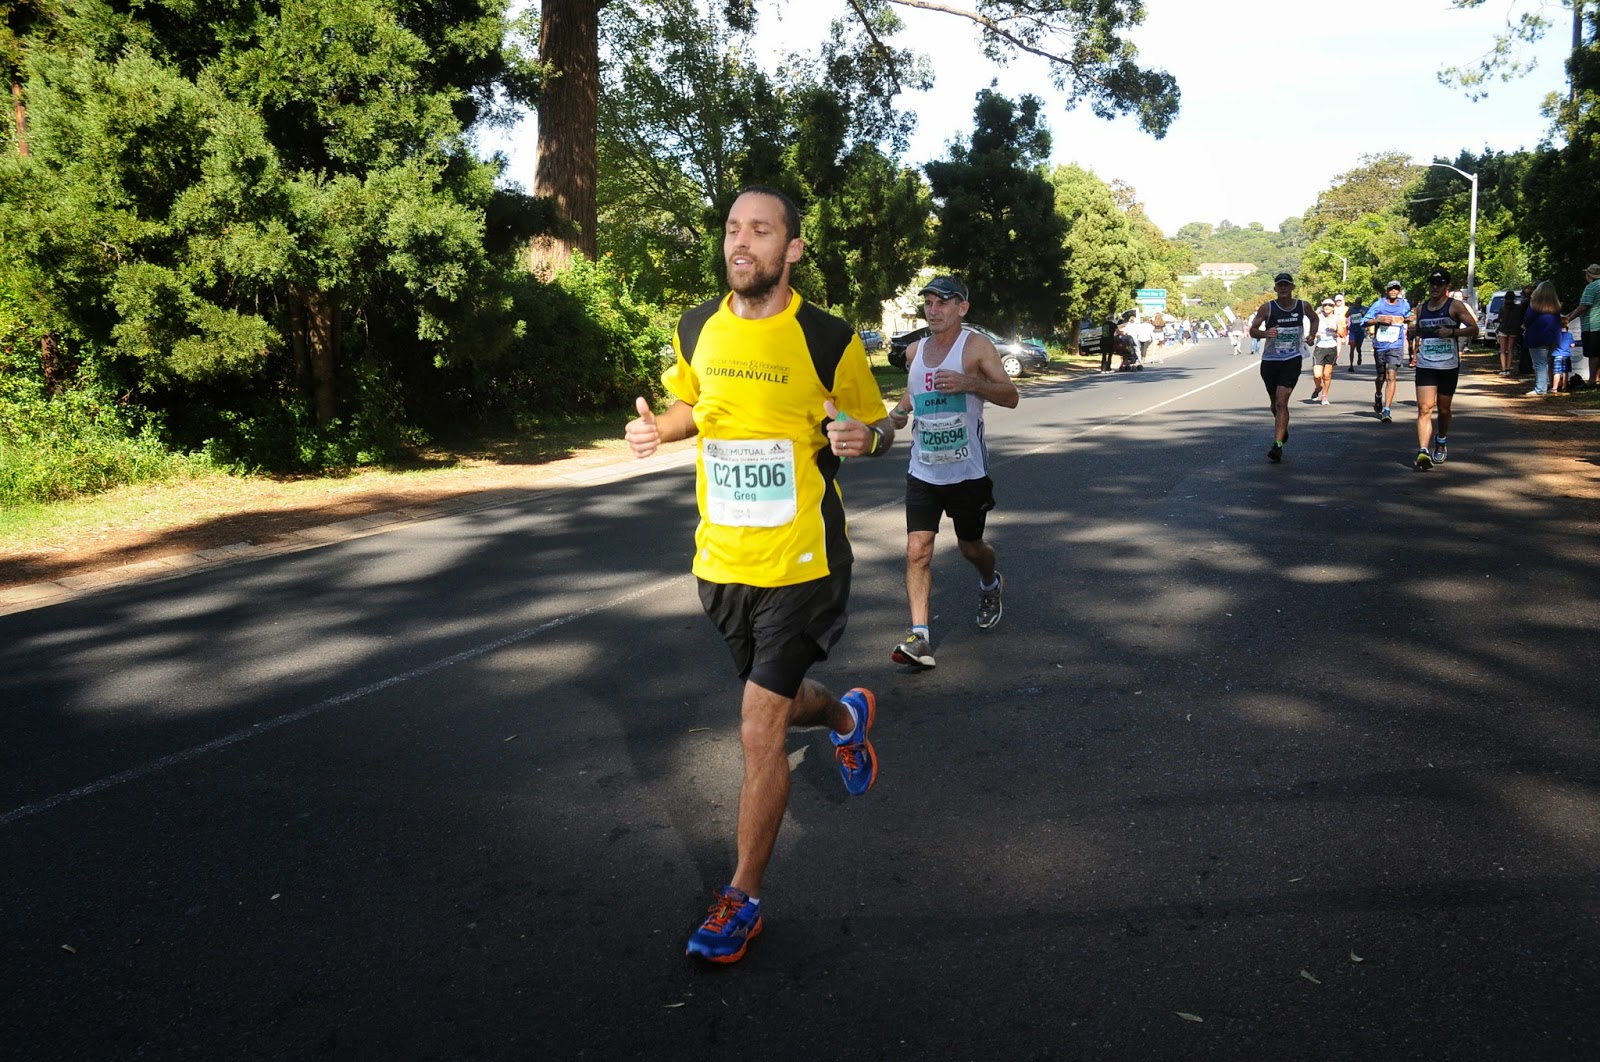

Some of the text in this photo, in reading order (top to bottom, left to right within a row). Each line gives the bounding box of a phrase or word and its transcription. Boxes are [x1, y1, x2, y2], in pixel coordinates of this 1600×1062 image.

[706, 367, 789, 384] DURBANVILLE
[922, 428, 964, 445] C26694
[954, 446, 969, 460] 50
[713, 462, 786, 488] C21506
[734, 490, 757, 502] Greg
